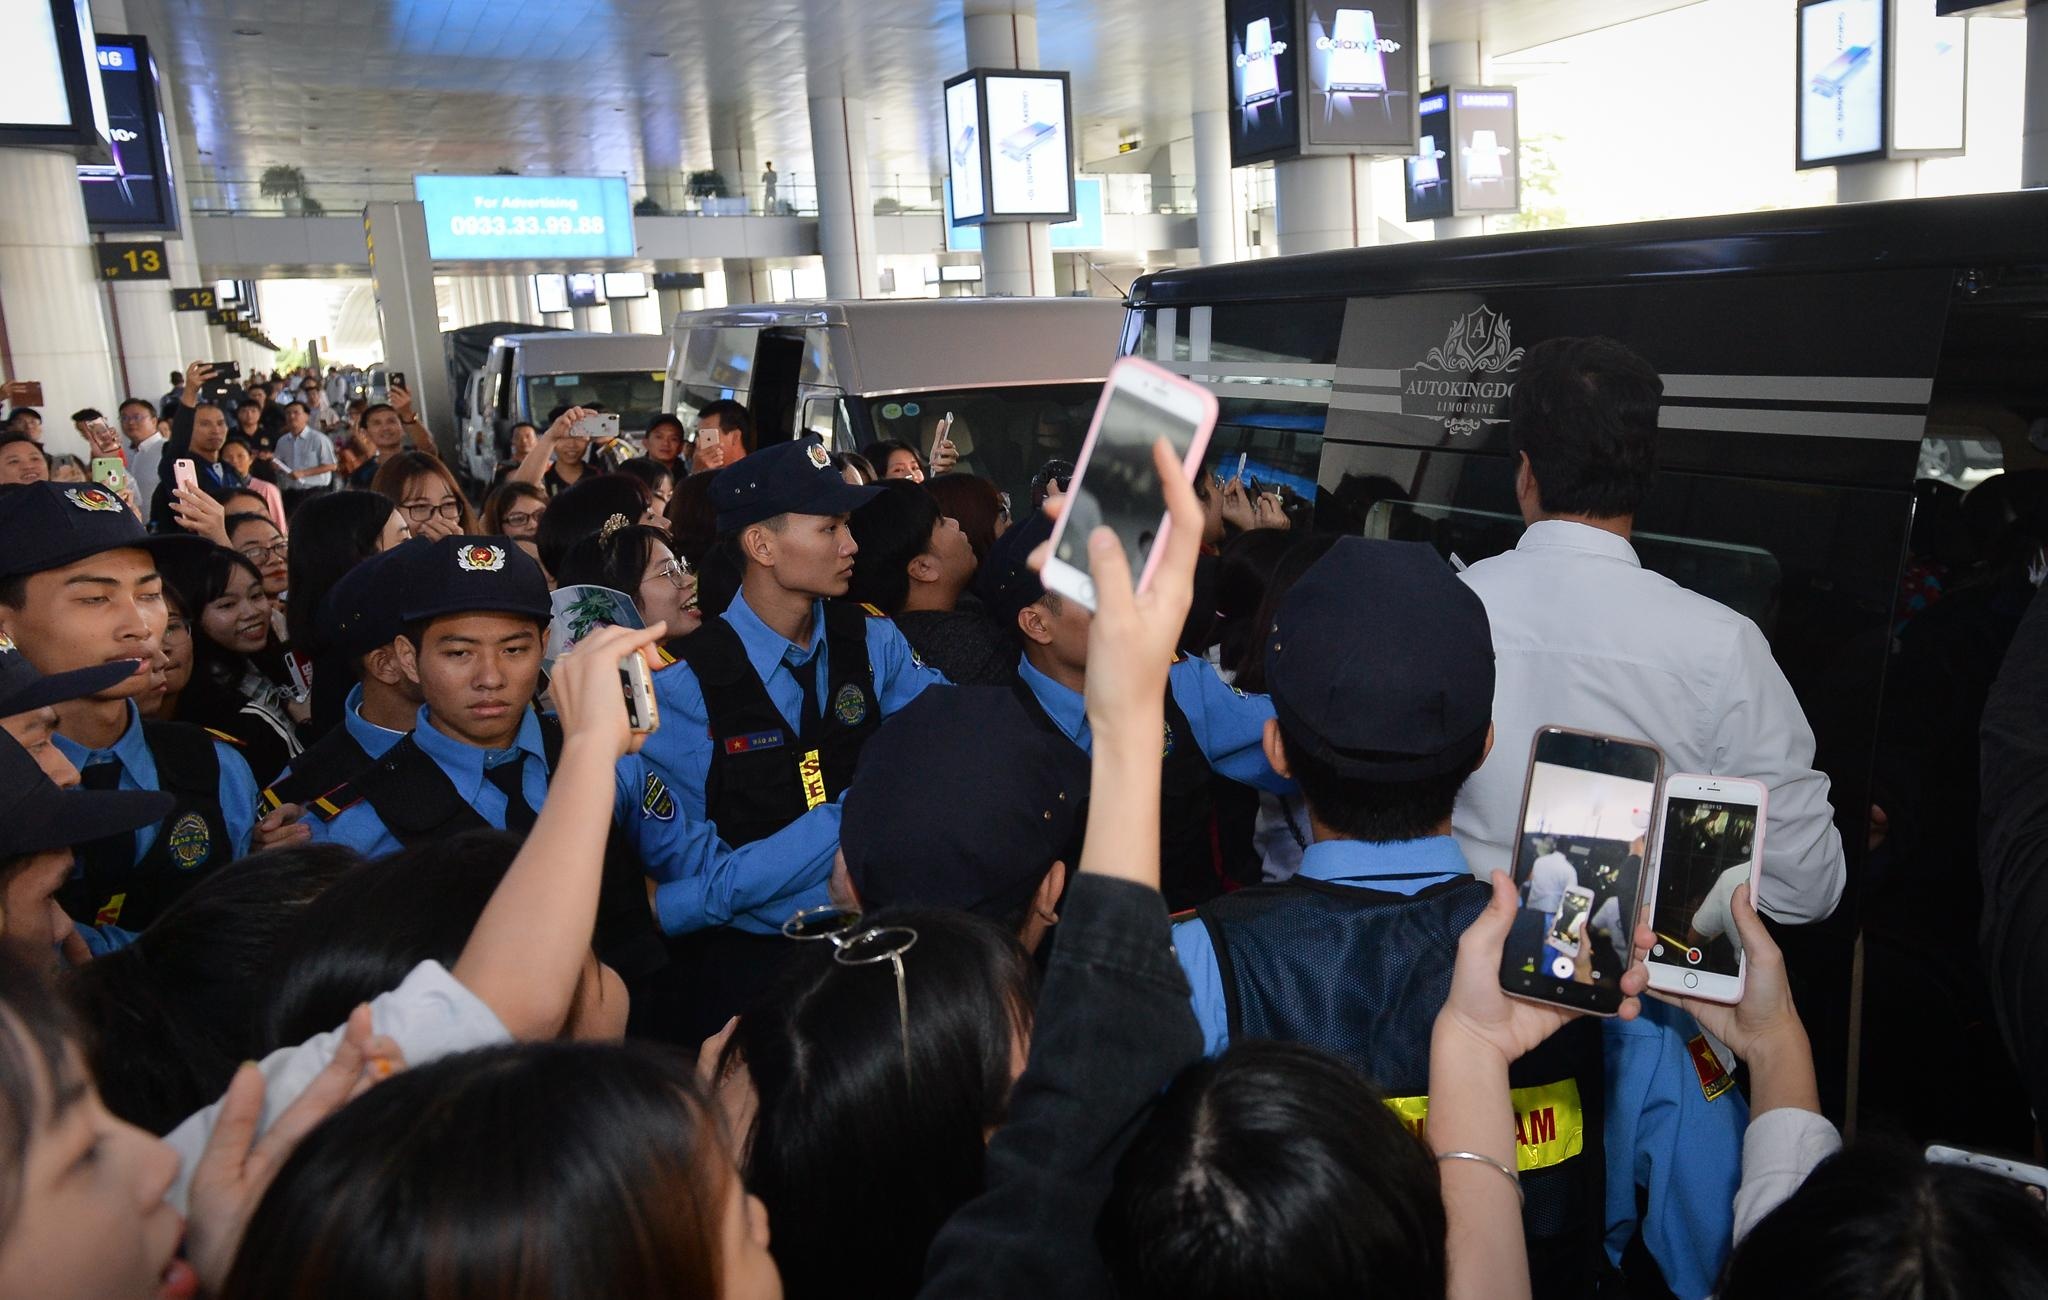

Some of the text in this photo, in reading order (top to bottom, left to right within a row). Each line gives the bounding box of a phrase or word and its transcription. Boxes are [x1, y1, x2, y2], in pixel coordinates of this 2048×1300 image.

[474, 196, 579, 212] For Advertising
[450, 215, 606, 236] 0933.33.99.88
[123, 250, 161, 273] 13
[190, 291, 213, 307] 12
[1470, 315, 1486, 338] A
[1437, 402, 1496, 414] LIMOUSINE
